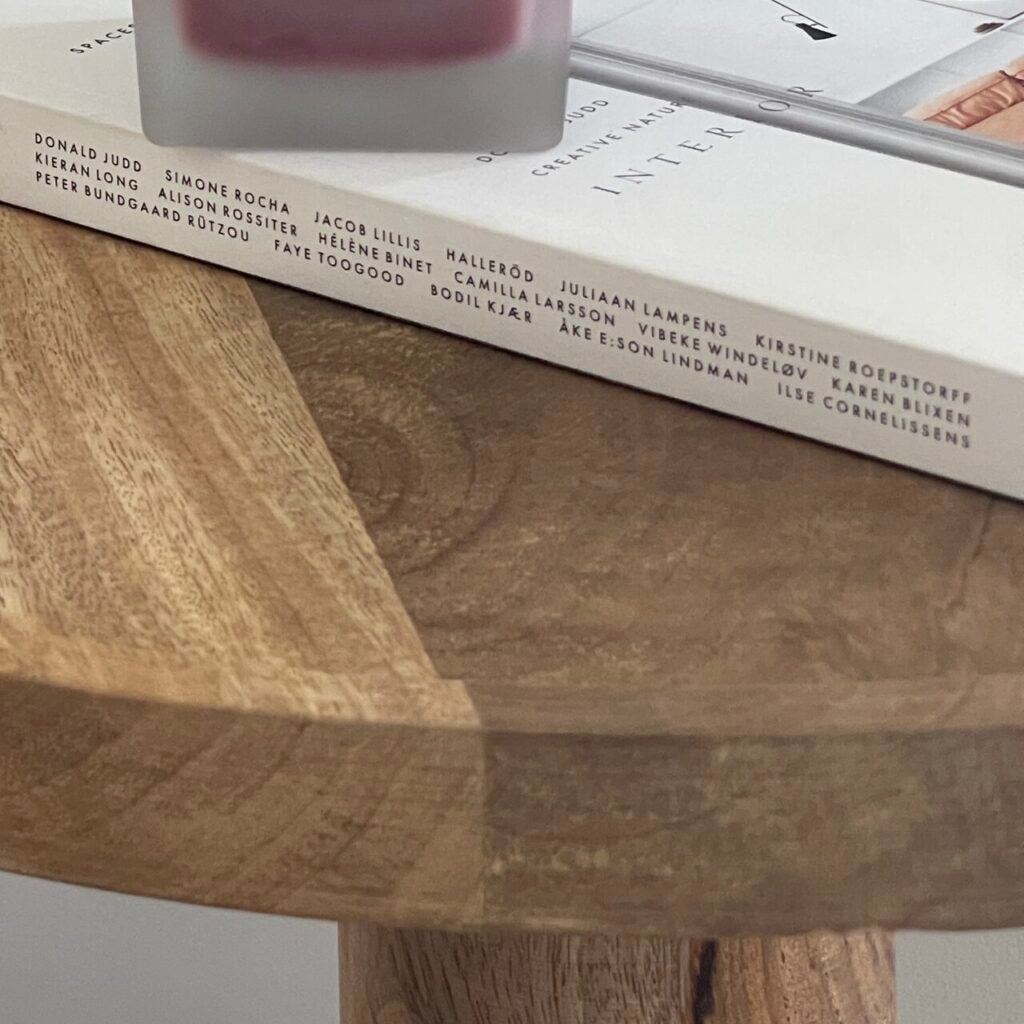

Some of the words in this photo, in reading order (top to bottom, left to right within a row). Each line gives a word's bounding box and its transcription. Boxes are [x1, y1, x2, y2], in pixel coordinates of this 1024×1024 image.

[35, 133, 97, 160] DONALD
[102, 151, 142, 173] JUDD
[165, 169, 228, 198] SIMONE
[235, 189, 291, 215] ROCHA
[314, 211, 367, 236] JACOB
[373, 227, 421, 251] LILLIS
[446, 248, 534, 283] HALLERÖD
[561, 280, 636, 311] JULIAAN
[643, 303, 727, 337] LAMPENS
[755, 334, 841, 369] KIRSTINE
[849, 360, 972, 404] ROEPSTORFF
[531, 132, 622, 176] CREATIVE
[622, 101, 687, 131] NATUR
[35, 152, 91, 179] KIERAN
[96, 168, 139, 191] LONG
[158, 188, 217, 214] ALISON
[223, 206, 298, 237] ROSSITER
[318, 232, 379, 260] HÉLÈNE
[385, 251, 433, 275] BINET
[454, 271, 528, 303] CAMILLA
[534, 293, 616, 326] LARSSON
[638, 323, 701, 351] VIBEKE
[708, 342, 807, 380] WINDELØV
[832, 377, 895, 406] KAREN
[902, 398, 971, 427] BLIXEN
[36, 171, 79, 193] PETER
[84, 186, 181, 223] BUNDGAARD
[188, 214, 250, 242] RÜTZOU
[274, 239, 311, 261] FAYE
[318, 251, 405, 287] TOOGOOD
[431, 284, 480, 309] BODIL
[487, 301, 532, 324] KJÆR
[559, 317, 592, 341] ÅKE
[600, 331, 654, 358] E:SON
[662, 349, 748, 385] LINDMAN
[777, 382, 815, 404] ILSE
[823, 395, 970, 449] CORNELISSENS
